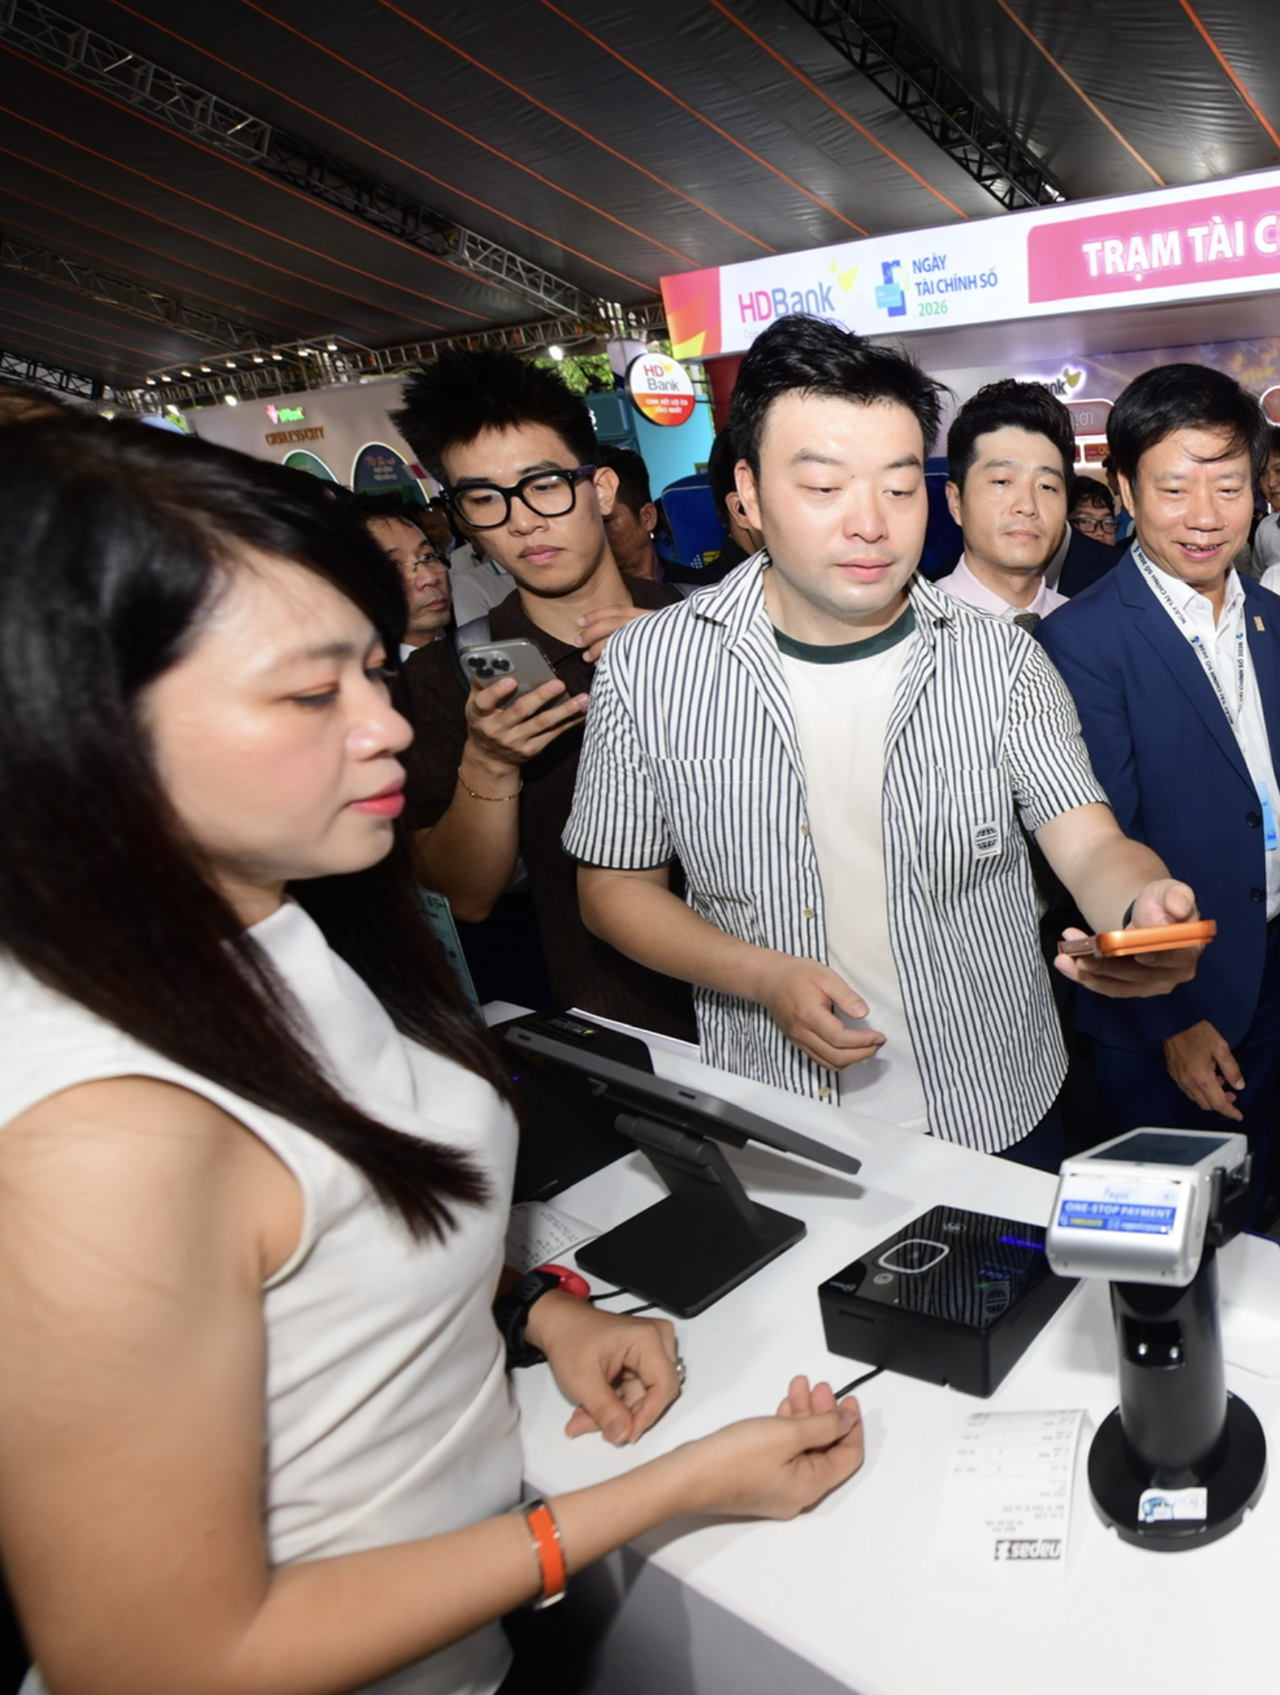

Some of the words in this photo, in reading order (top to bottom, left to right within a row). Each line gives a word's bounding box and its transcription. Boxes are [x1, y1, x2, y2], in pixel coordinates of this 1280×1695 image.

[1082, 232, 1182, 281] TRẠM
[1188, 215, 1245, 262] TÀI
[912, 252, 946, 274] NGÀY
[915, 278, 934, 296] TÀI
[936, 274, 977, 293] CHÍNH
[979, 266, 998, 288] SỐ
[738, 282, 835, 323] HDBank
[918, 300, 948, 316] 2026
[643, 365, 664, 377] HD
[647, 377, 679, 391] Bank
[1065, 1202, 1119, 1216] ONE-STOP
[1120, 1205, 1172, 1219] PAYMENT
